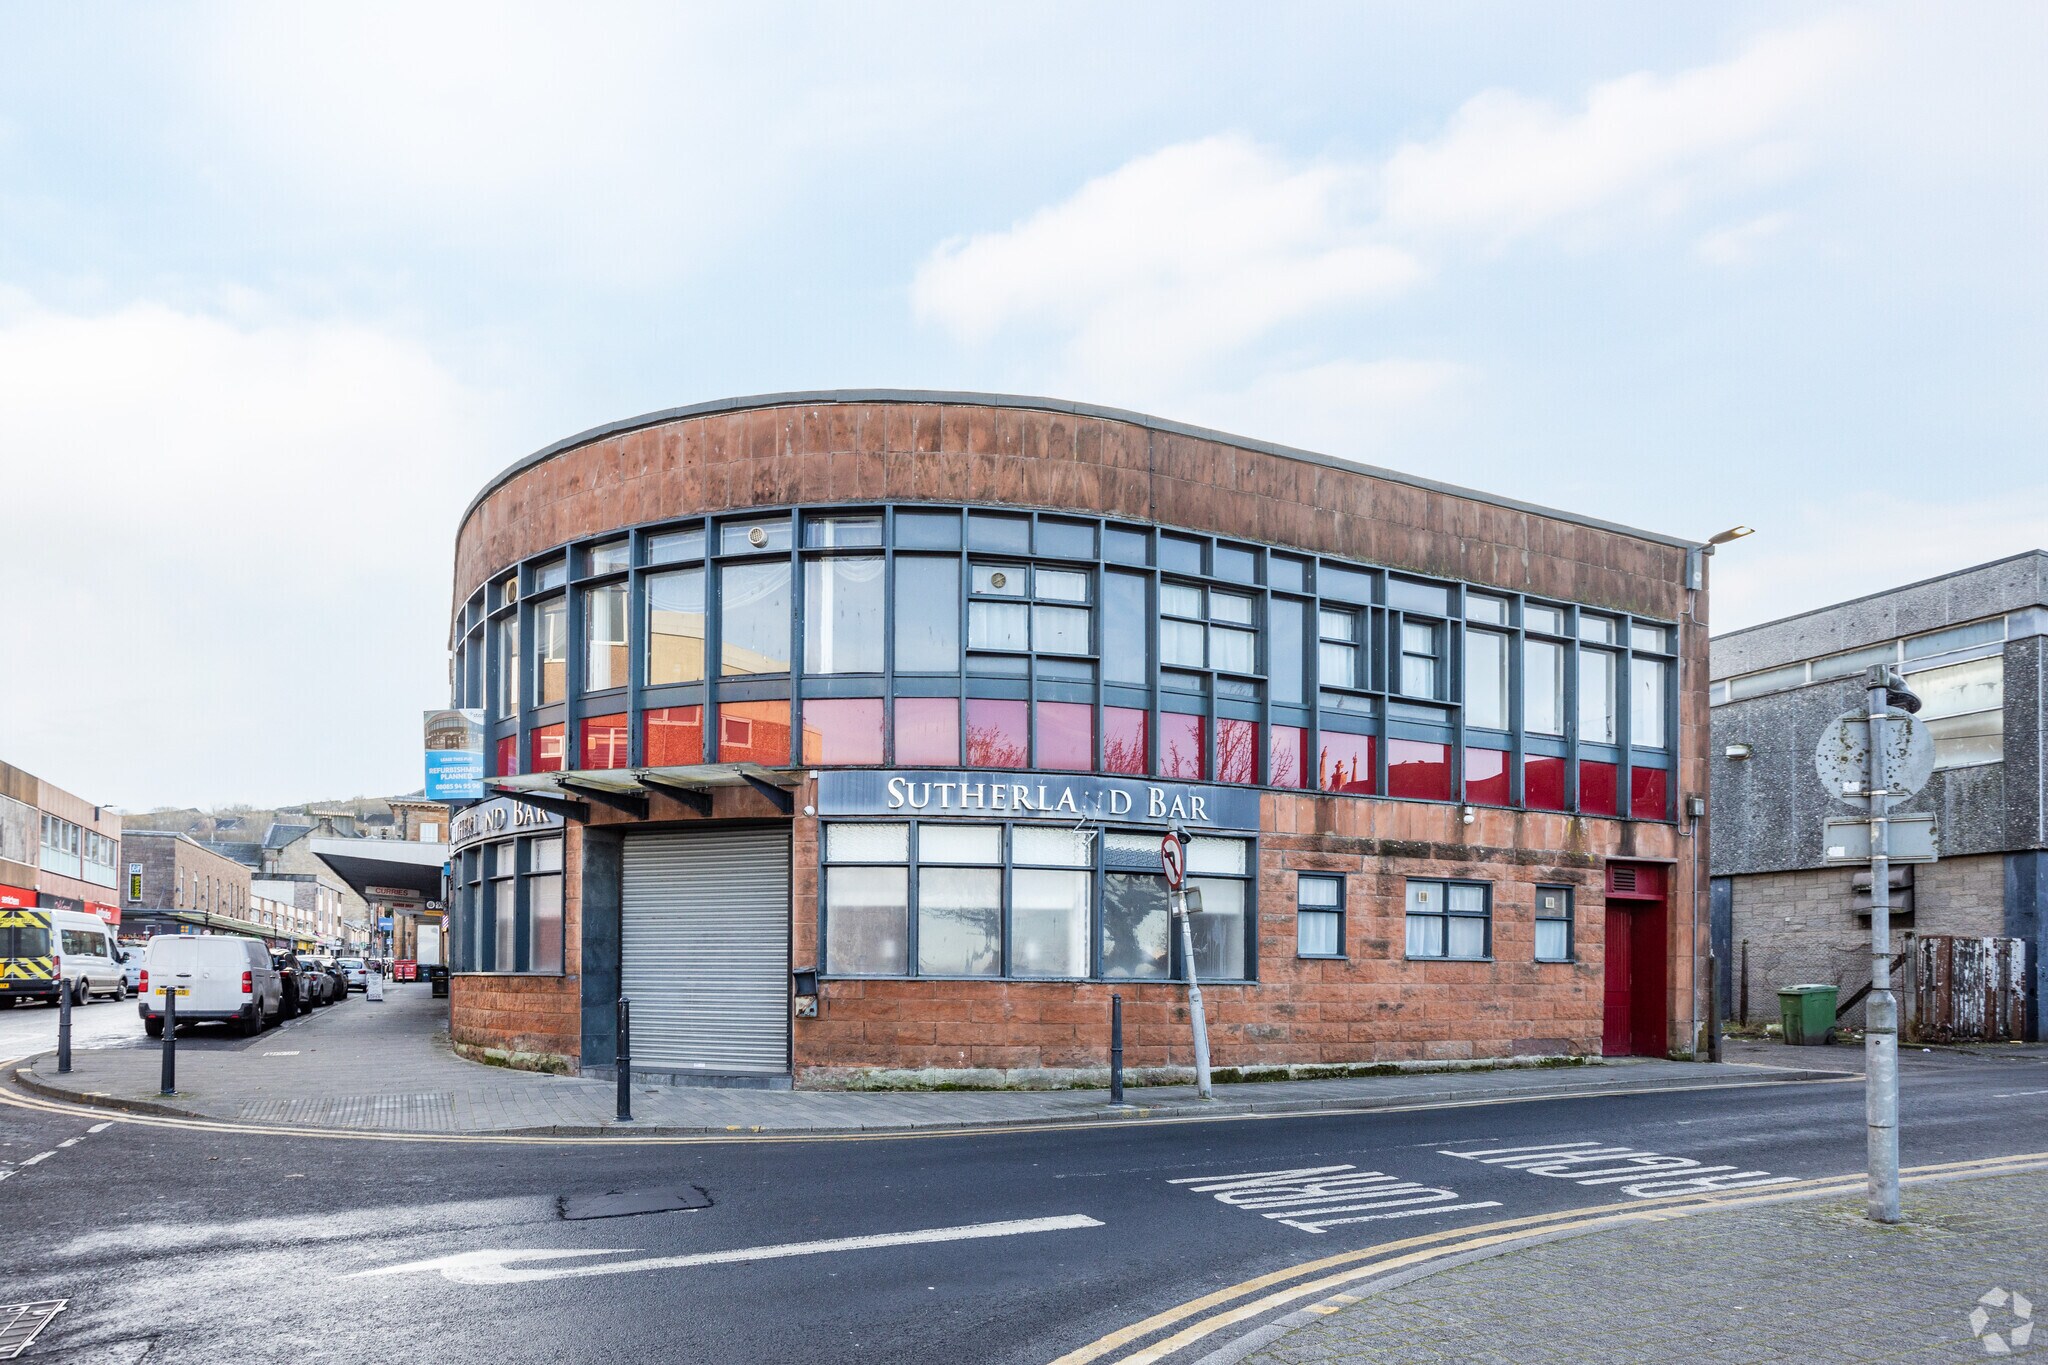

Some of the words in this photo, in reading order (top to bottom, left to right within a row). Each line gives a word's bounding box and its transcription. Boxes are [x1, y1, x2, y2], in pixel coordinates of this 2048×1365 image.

[887, 777, 1132, 815] SUTHERLAD
[1148, 786, 1210, 821] BAR
[375, 887, 409, 897] CURRIES
[1436, 1141, 1802, 1198] RIGHT
[1166, 1163, 1504, 1234] TURN
